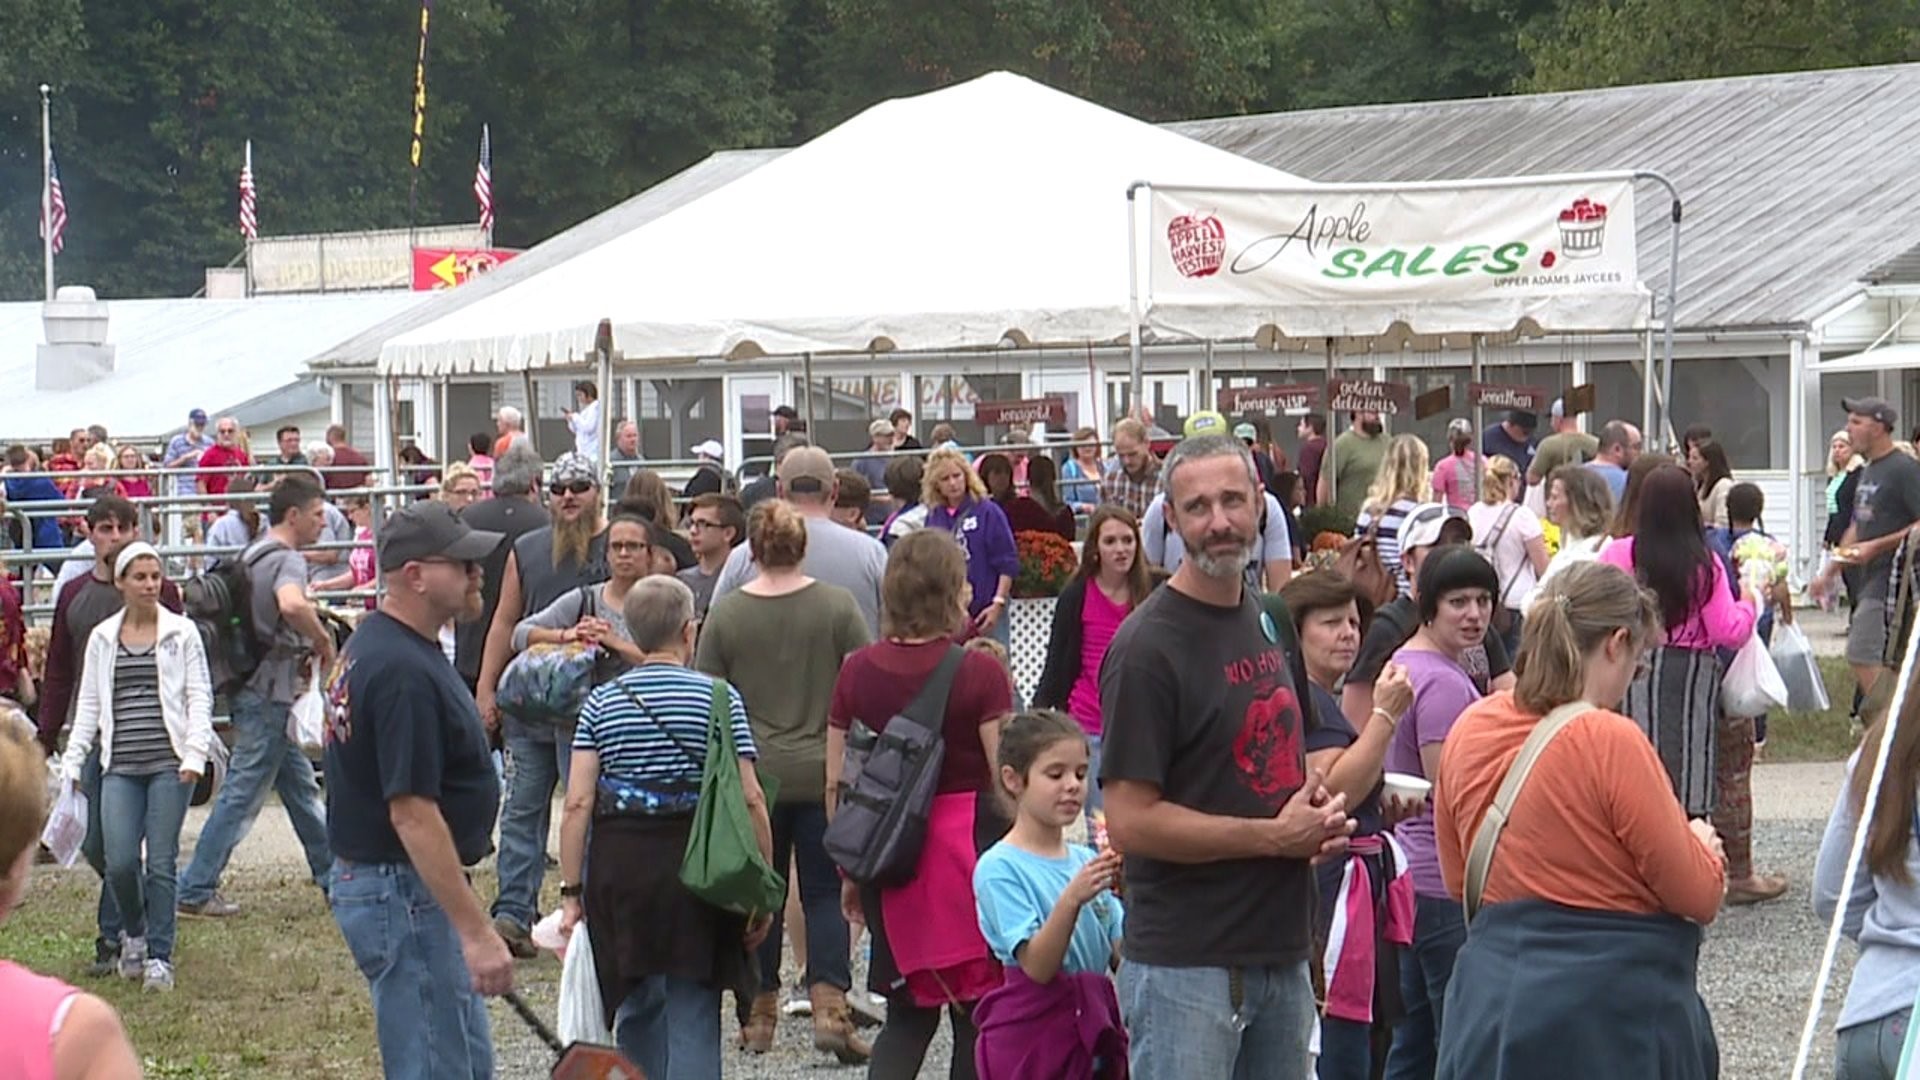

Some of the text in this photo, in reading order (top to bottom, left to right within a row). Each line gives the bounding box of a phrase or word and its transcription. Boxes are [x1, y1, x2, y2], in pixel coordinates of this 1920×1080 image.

[1171, 226, 1210, 247] APPLE
[1230, 202, 1372, 275] Apple
[1172, 240, 1223, 262] HARVEST
[1322, 241, 1528, 278] SALES
[1493, 272, 1622, 288] UPPER ADAMS JAYCEES
[1340, 381, 1383, 397] golden
[1331, 394, 1397, 414] delicious
